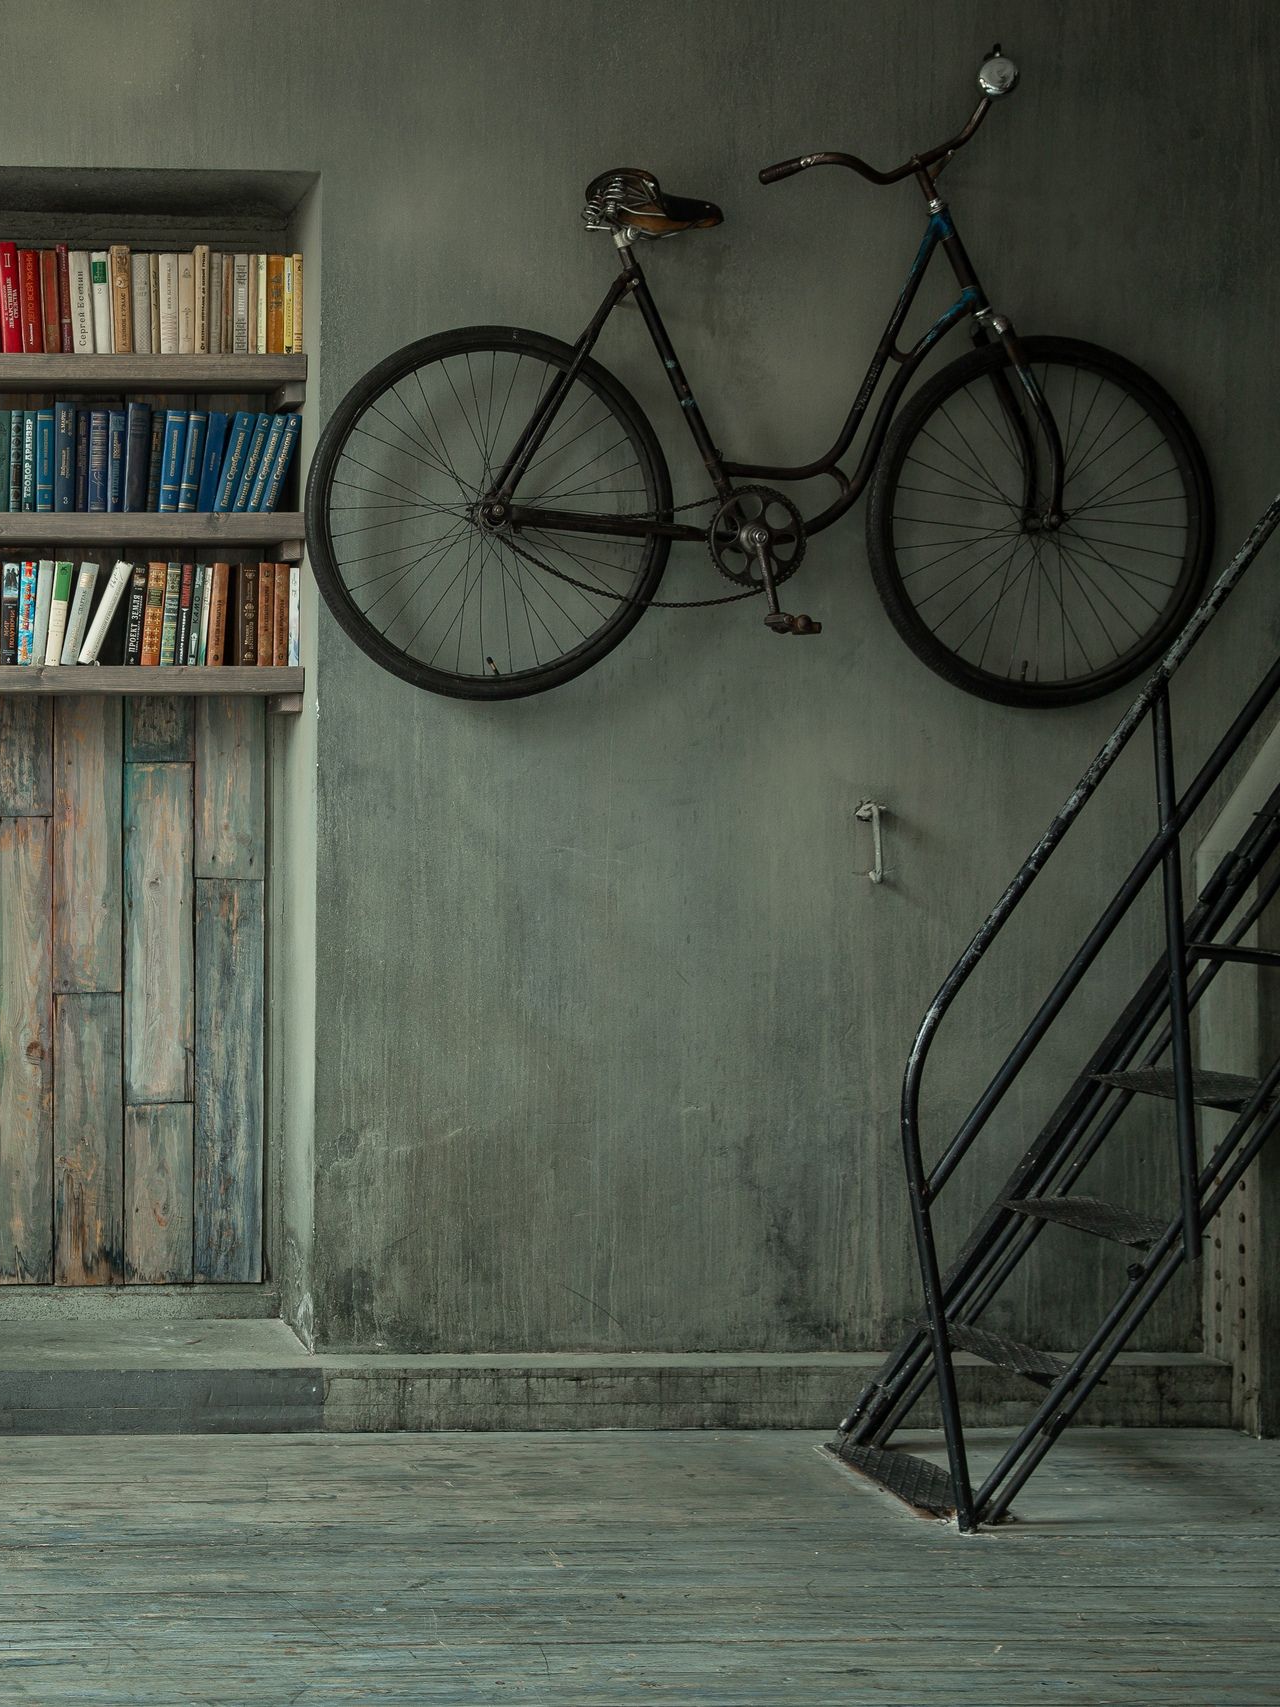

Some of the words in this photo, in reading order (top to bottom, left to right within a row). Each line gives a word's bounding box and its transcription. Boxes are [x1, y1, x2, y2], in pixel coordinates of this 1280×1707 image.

[6, 277, 15, 329] ЛЕКАРСТВЕННЫЕ
[26, 282, 34, 301] ВСЕЙ
[77, 271, 85, 308] Есенин
[27, 303, 35, 322] ДЕЛО
[78, 312, 88, 346] Сергей
[243, 417, 249, 426] 1
[262, 418, 269, 427] 2
[275, 418, 283, 427] 5
[290, 418, 296, 427] 6
[25, 419, 33, 461] ДРАЙЗЕР
[24, 462, 32, 498] ТЕОДОР
[220, 481, 233, 507] Галина
[227, 432, 246, 480] Серебрякова
[237, 482, 250, 507] Галина
[244, 433, 264, 481] Серебрякова
[250, 481, 264, 507] Галина
[259, 432, 279, 480] Серебрякова
[266, 481, 279, 507] Галина
[273, 433, 293, 480] Серебрякова
[78, 590, 87, 615] СПАРТАК
[131, 594, 140, 620] ЗЕМЛЯ
[192, 595, 200, 624] КАМО
[128, 623, 138, 652] ПРОЕКТ
